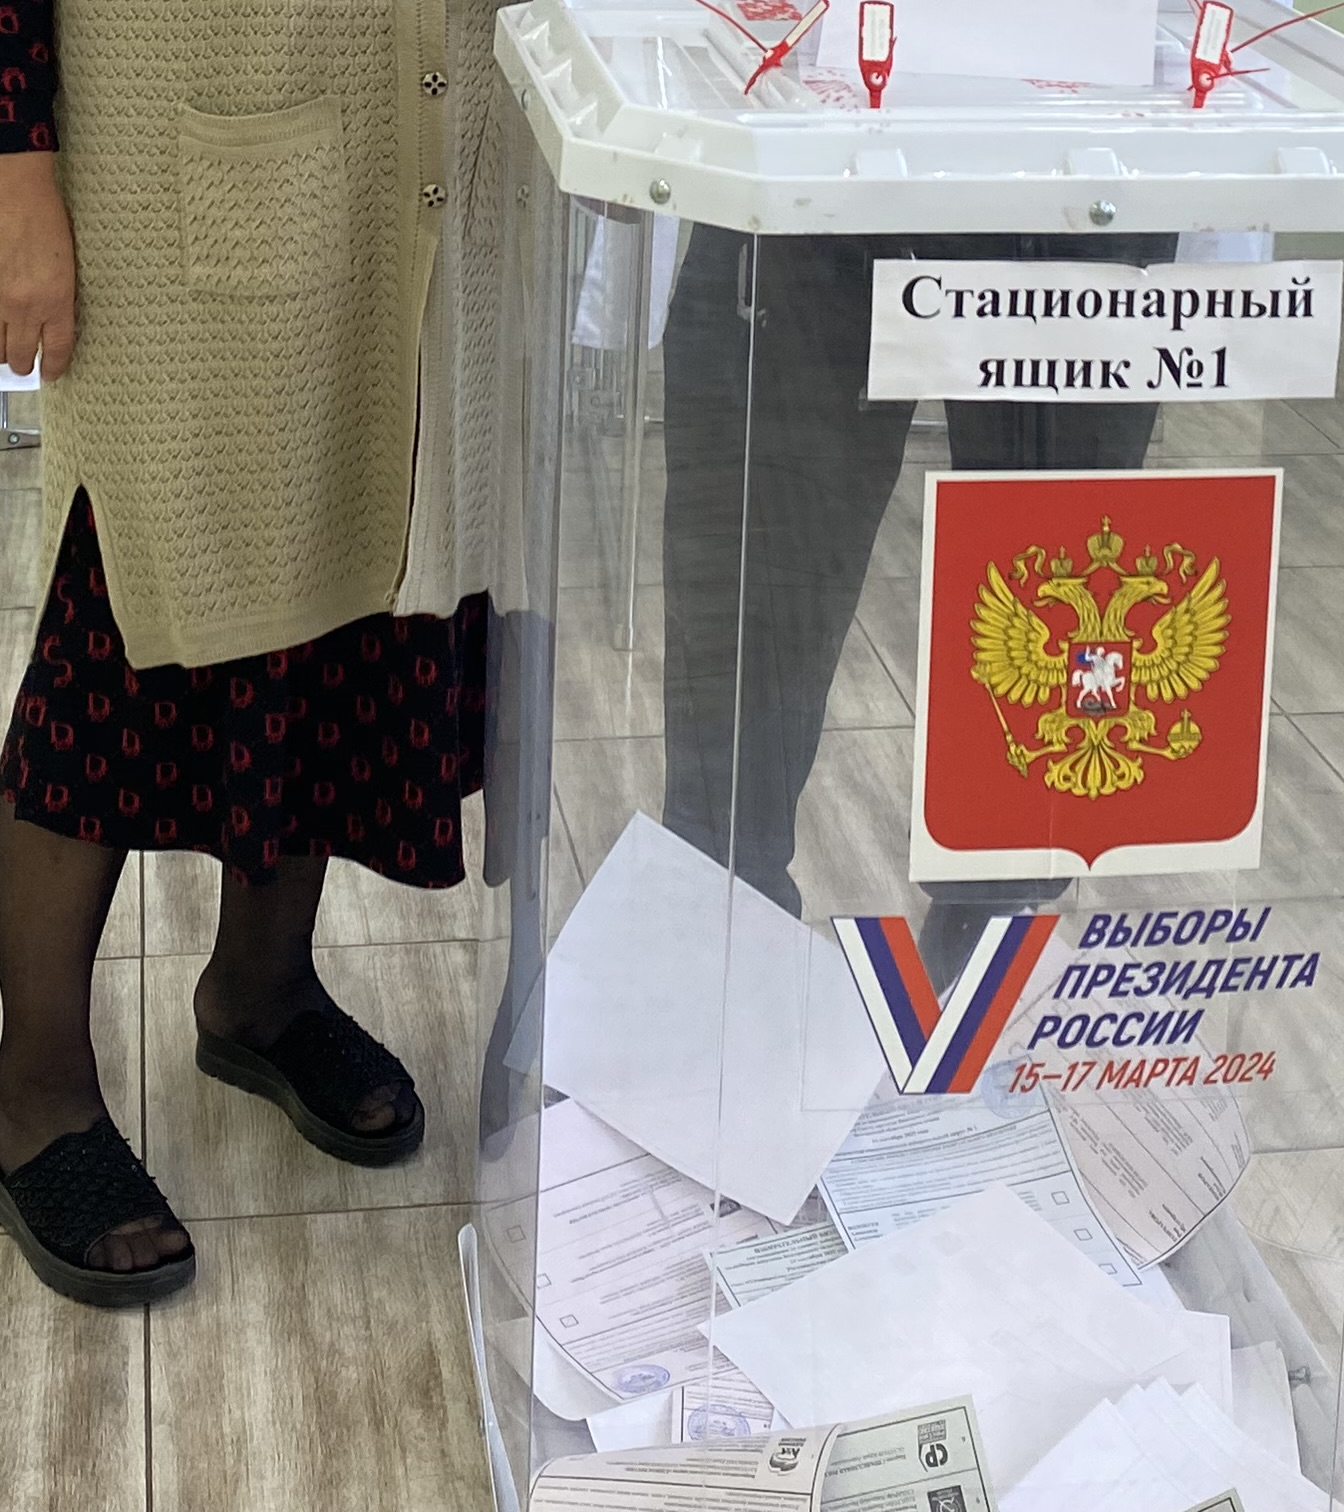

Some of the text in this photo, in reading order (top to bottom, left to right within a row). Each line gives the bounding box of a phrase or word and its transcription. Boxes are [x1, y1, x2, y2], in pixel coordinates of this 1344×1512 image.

[901, 275, 1314, 331] Стационарный
[978, 346, 1230, 394] ящик №1
[1078, 907, 1272, 950] ВЫБОРЫ
[1053, 952, 1320, 1000] ПРЕЗИДЕНТА
[1027, 1010, 1203, 1050] РОССИИ
[1096, 1057, 1198, 1090] МАРТА
[1203, 1051, 1277, 1085] 2024
